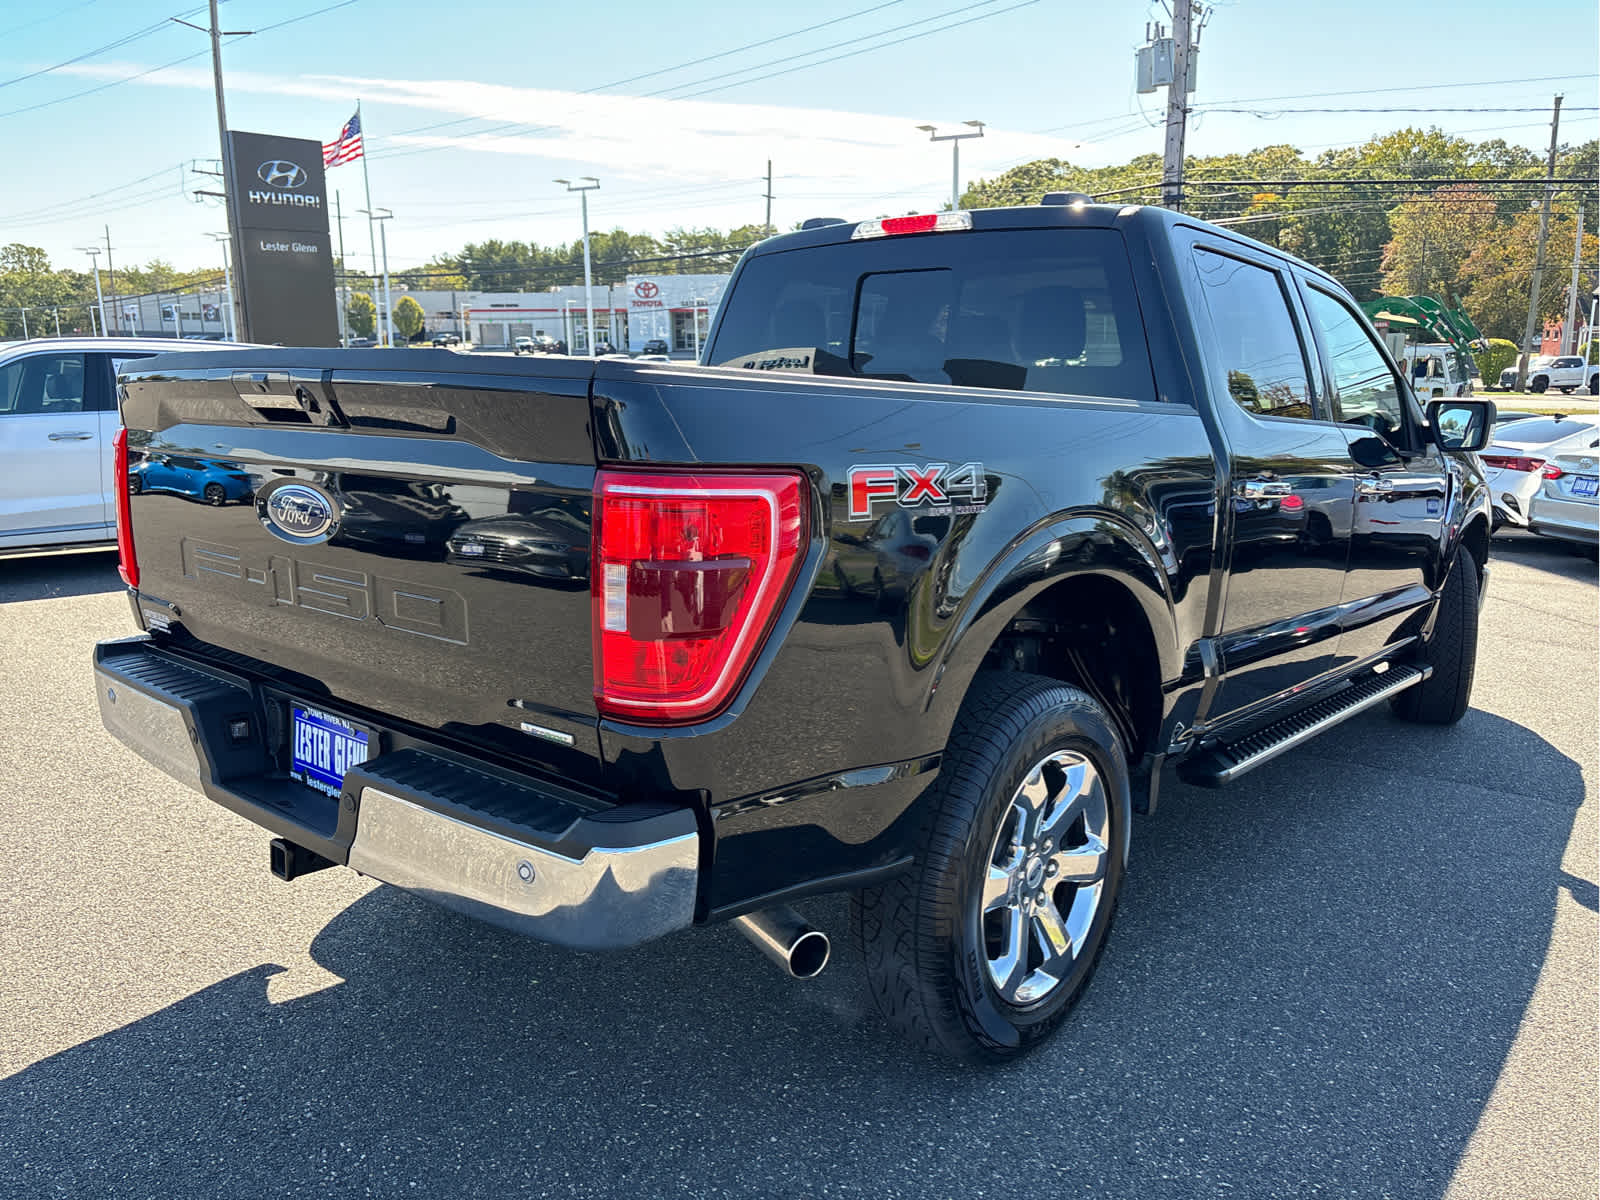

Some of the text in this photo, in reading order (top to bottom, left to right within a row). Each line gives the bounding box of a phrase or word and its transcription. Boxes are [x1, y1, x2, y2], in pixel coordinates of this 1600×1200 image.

[248, 190, 320, 208] HYUNDAI
[260, 240, 317, 253] Lester Glenn
[277, 495, 313, 526] Ford
[847, 462, 987, 522] FX4
[180, 536, 469, 646] F-150
[295, 720, 331, 771] LESTER
